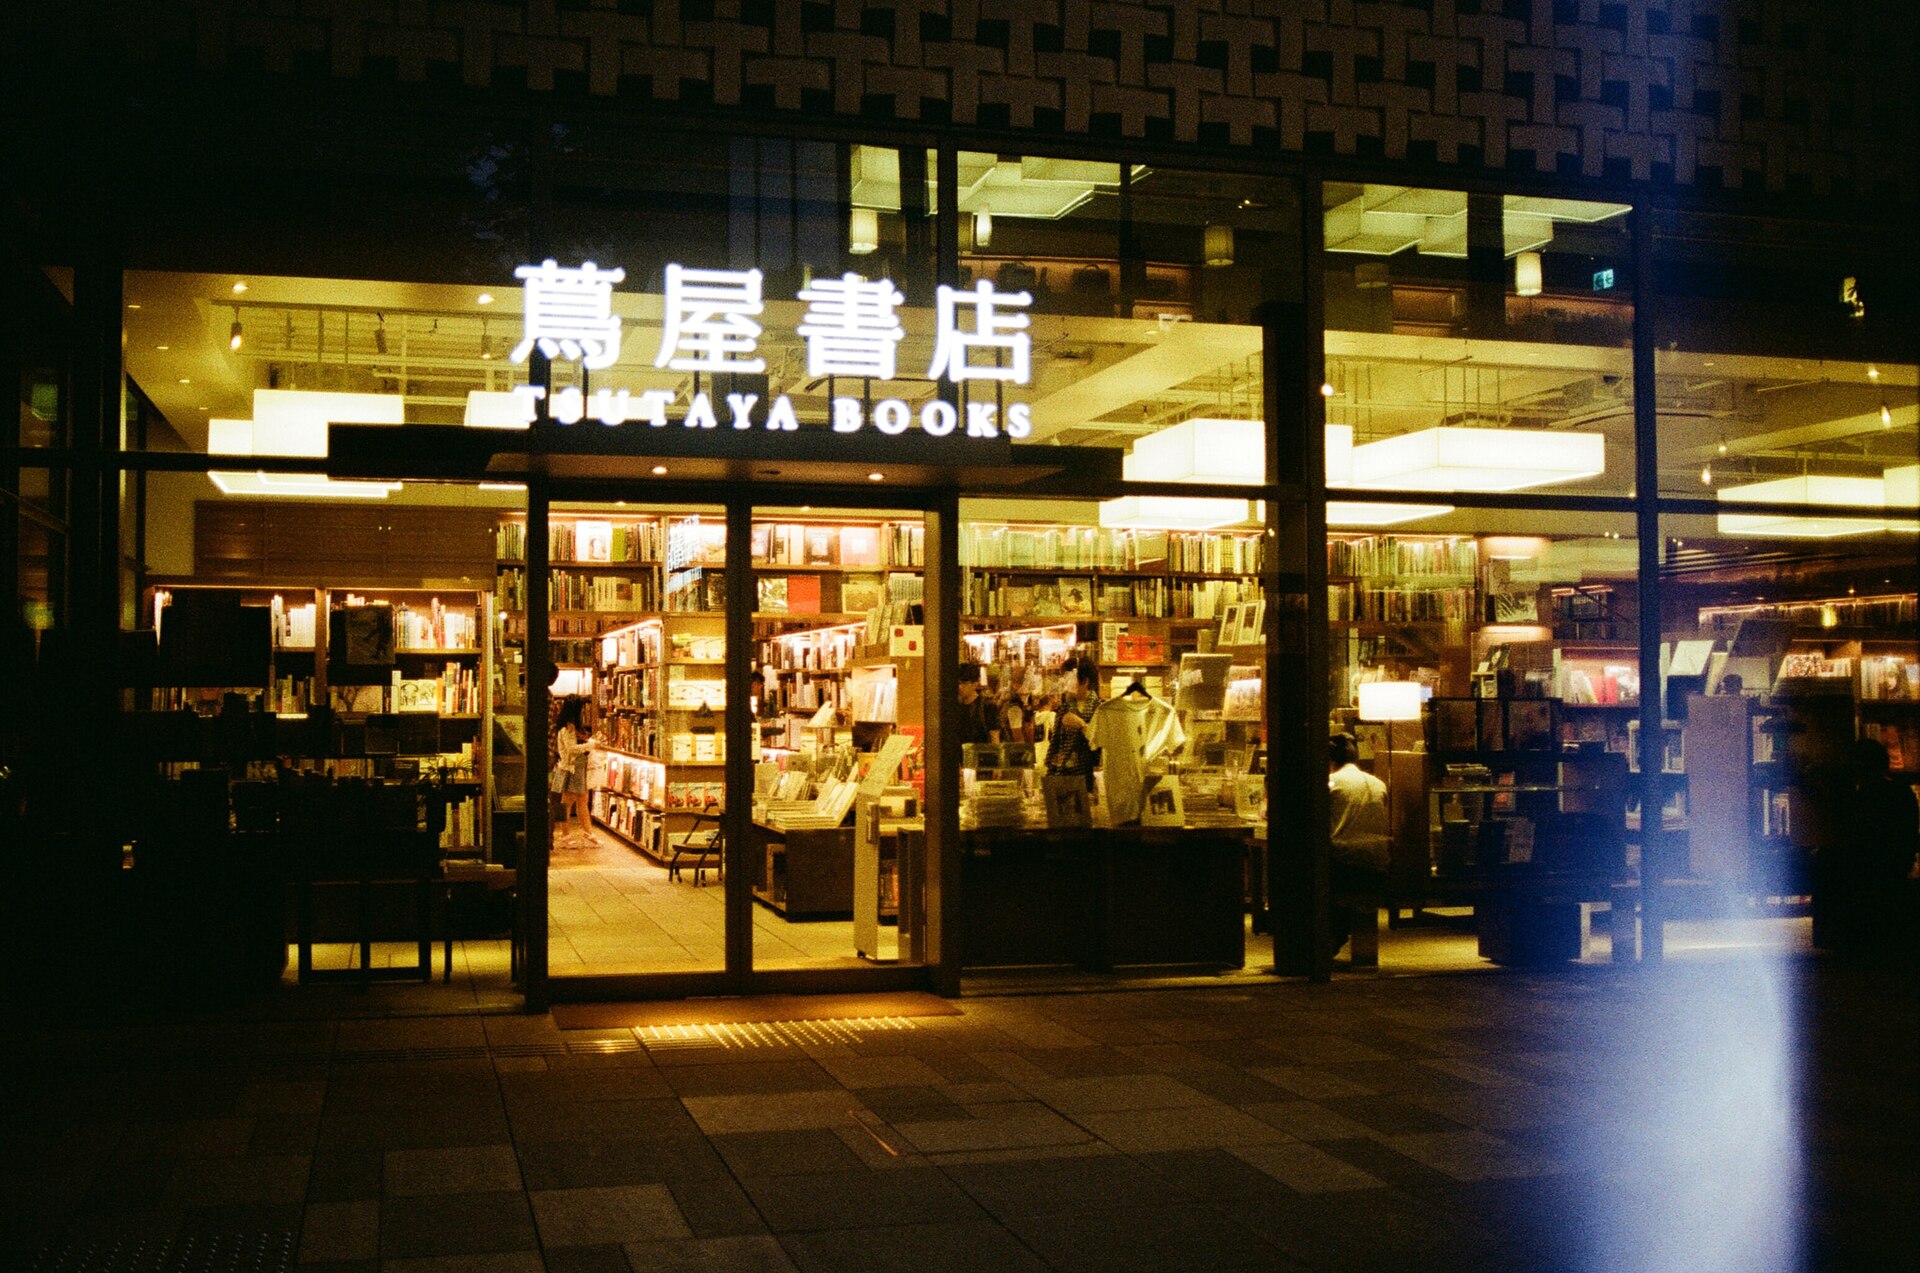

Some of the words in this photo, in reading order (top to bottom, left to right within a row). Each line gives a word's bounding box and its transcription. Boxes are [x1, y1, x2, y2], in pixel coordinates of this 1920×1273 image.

[510, 259, 1033, 384] 蔦屋書店
[513, 384, 800, 431] TSUTAYA
[832, 396, 1033, 439] BOOKS
